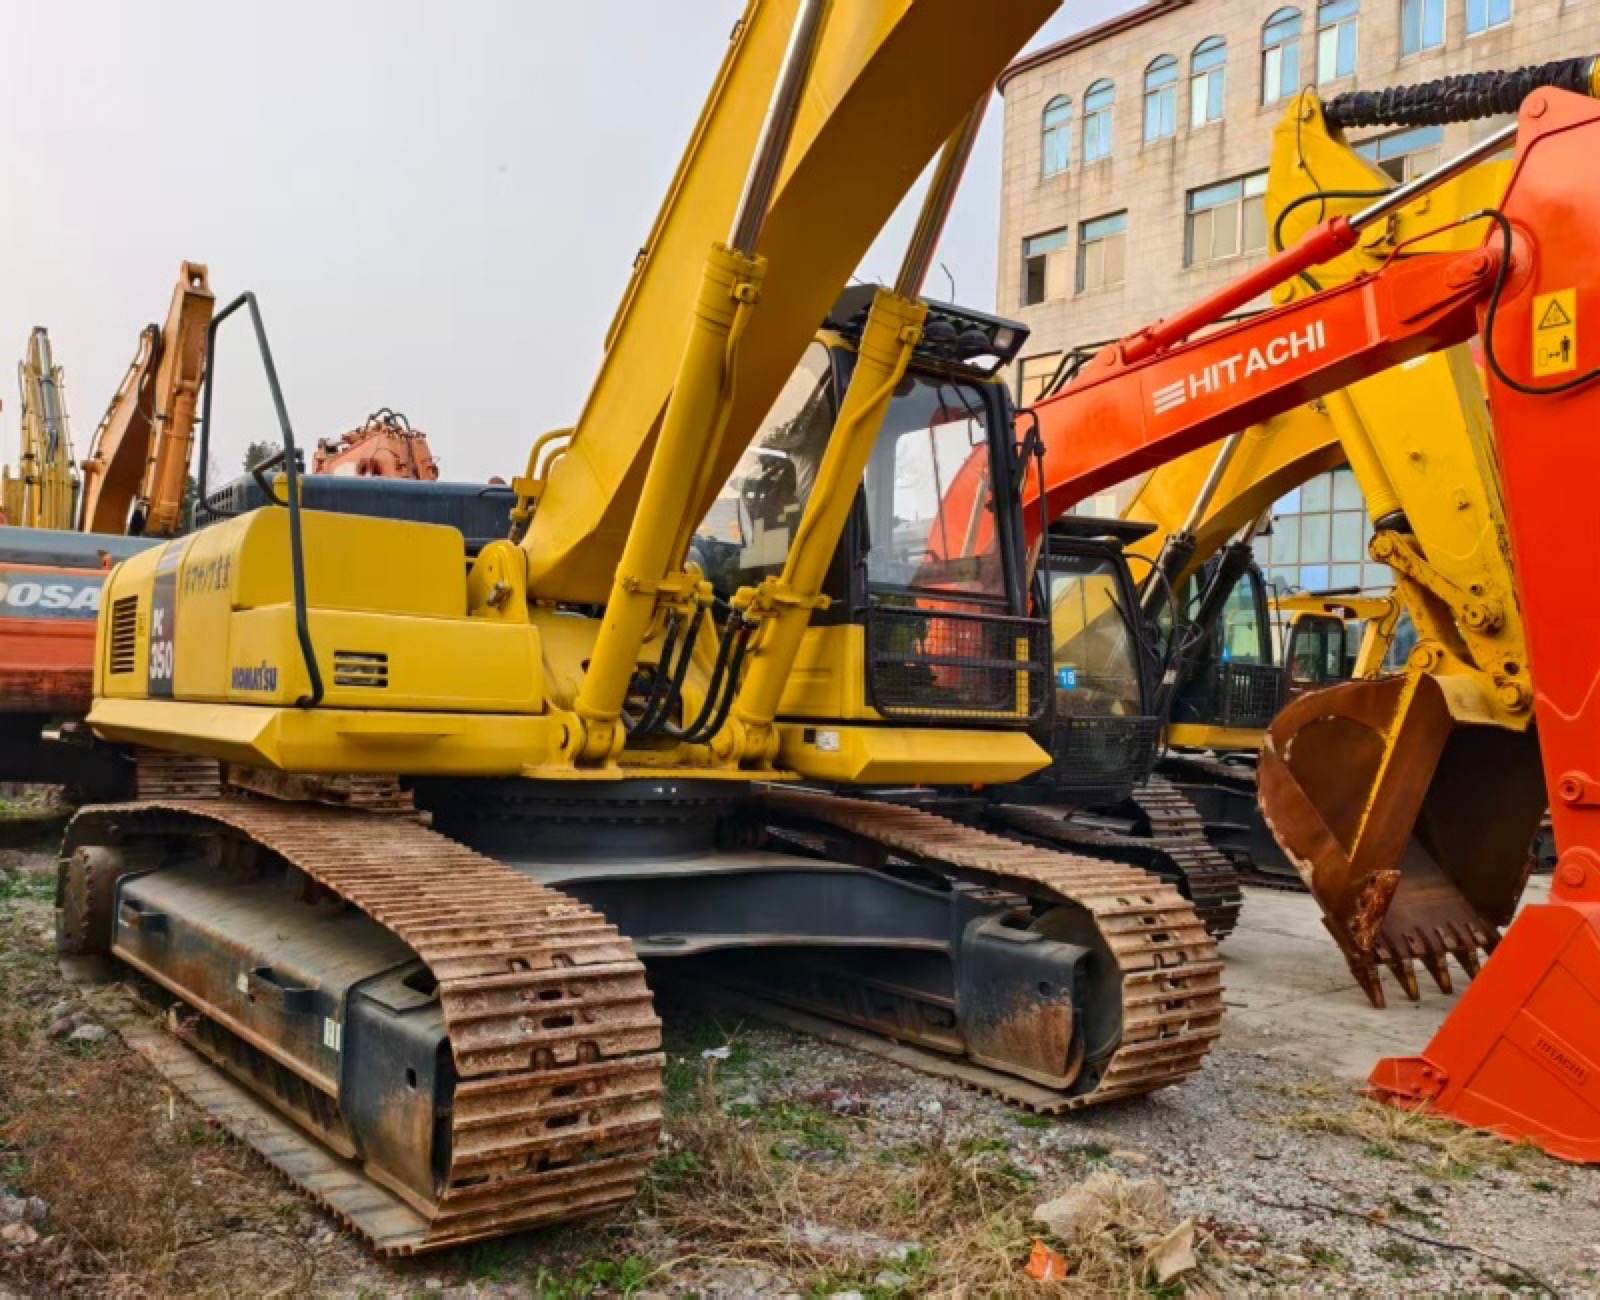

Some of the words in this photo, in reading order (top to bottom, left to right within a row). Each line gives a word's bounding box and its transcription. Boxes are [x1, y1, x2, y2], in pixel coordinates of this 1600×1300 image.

[1189, 320, 1326, 399] HITACHI
[0, 581, 101, 610] OSA
[231, 660, 276, 692] KOMATSU
[1061, 671, 1075, 684] 18
[1537, 1039, 1585, 1079] HITACHI
